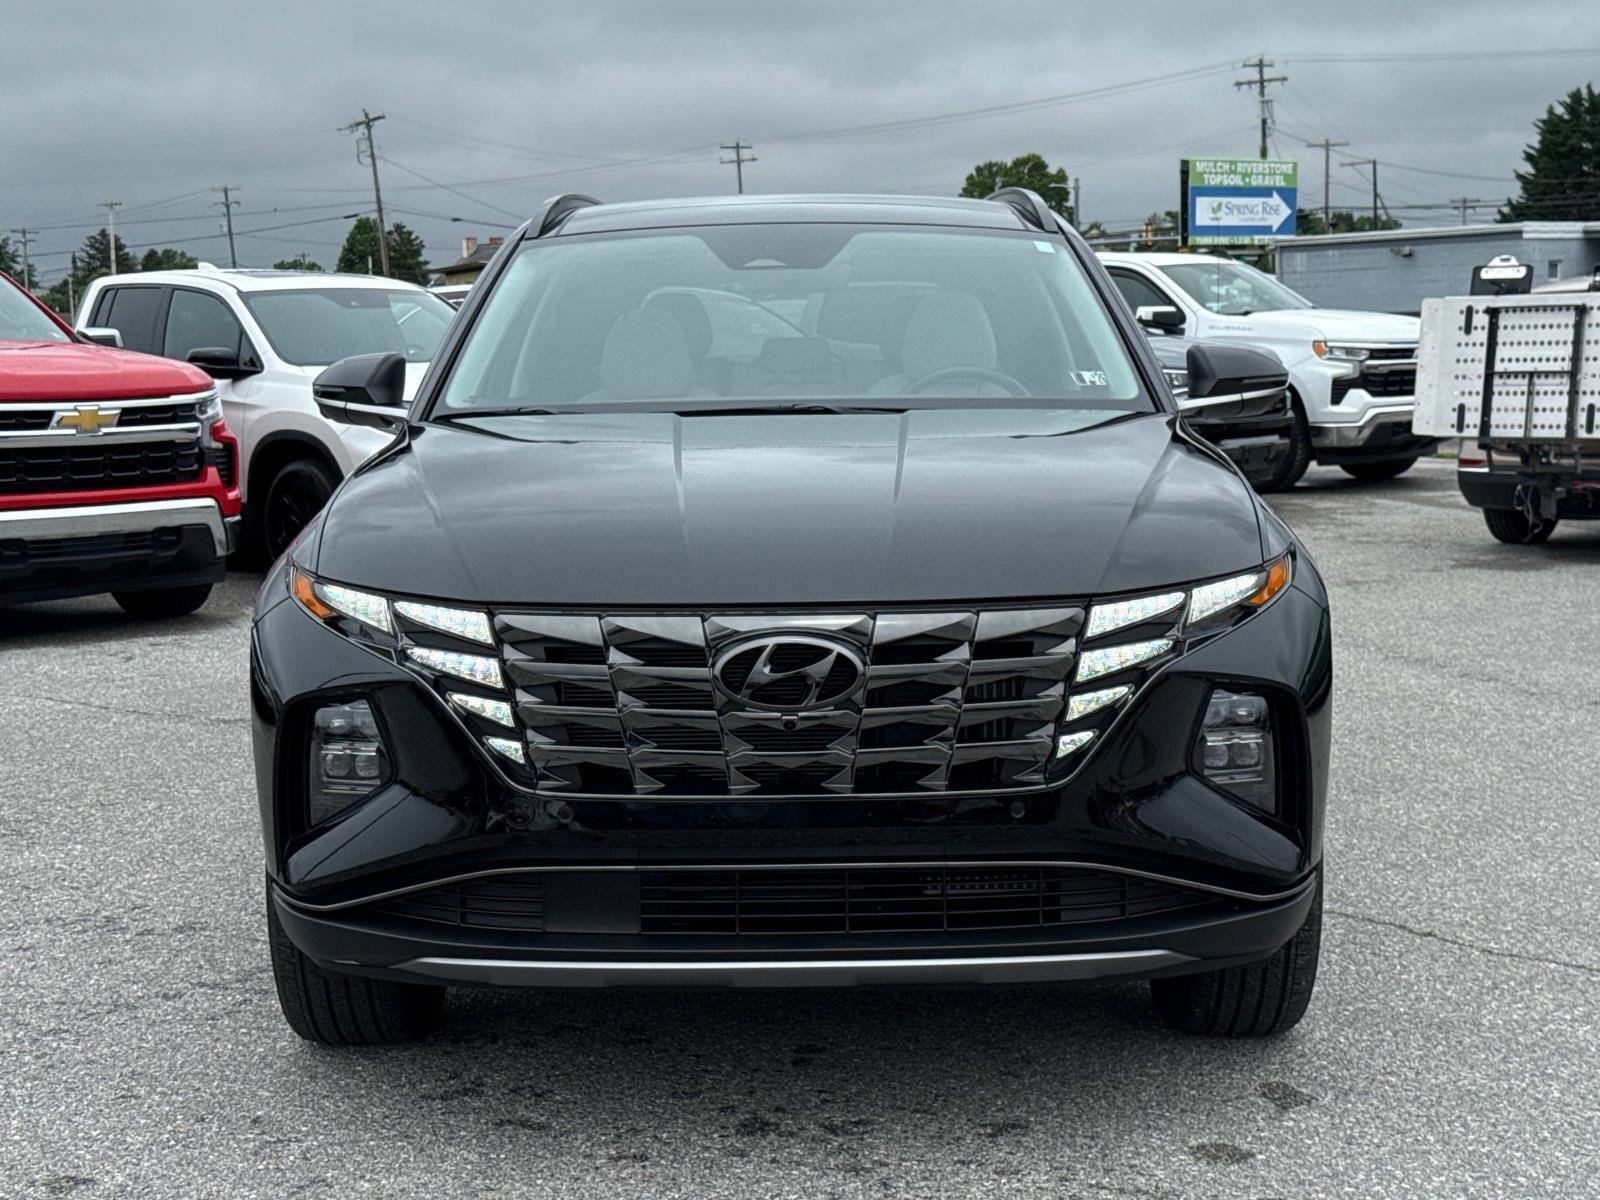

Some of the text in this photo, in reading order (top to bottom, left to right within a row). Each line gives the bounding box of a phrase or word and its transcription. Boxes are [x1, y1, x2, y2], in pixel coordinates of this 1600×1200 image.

[1196, 161, 1293, 174] MULCH RIVERSTONE
[1203, 174, 1286, 186] TOPSOIL GRAVEL
